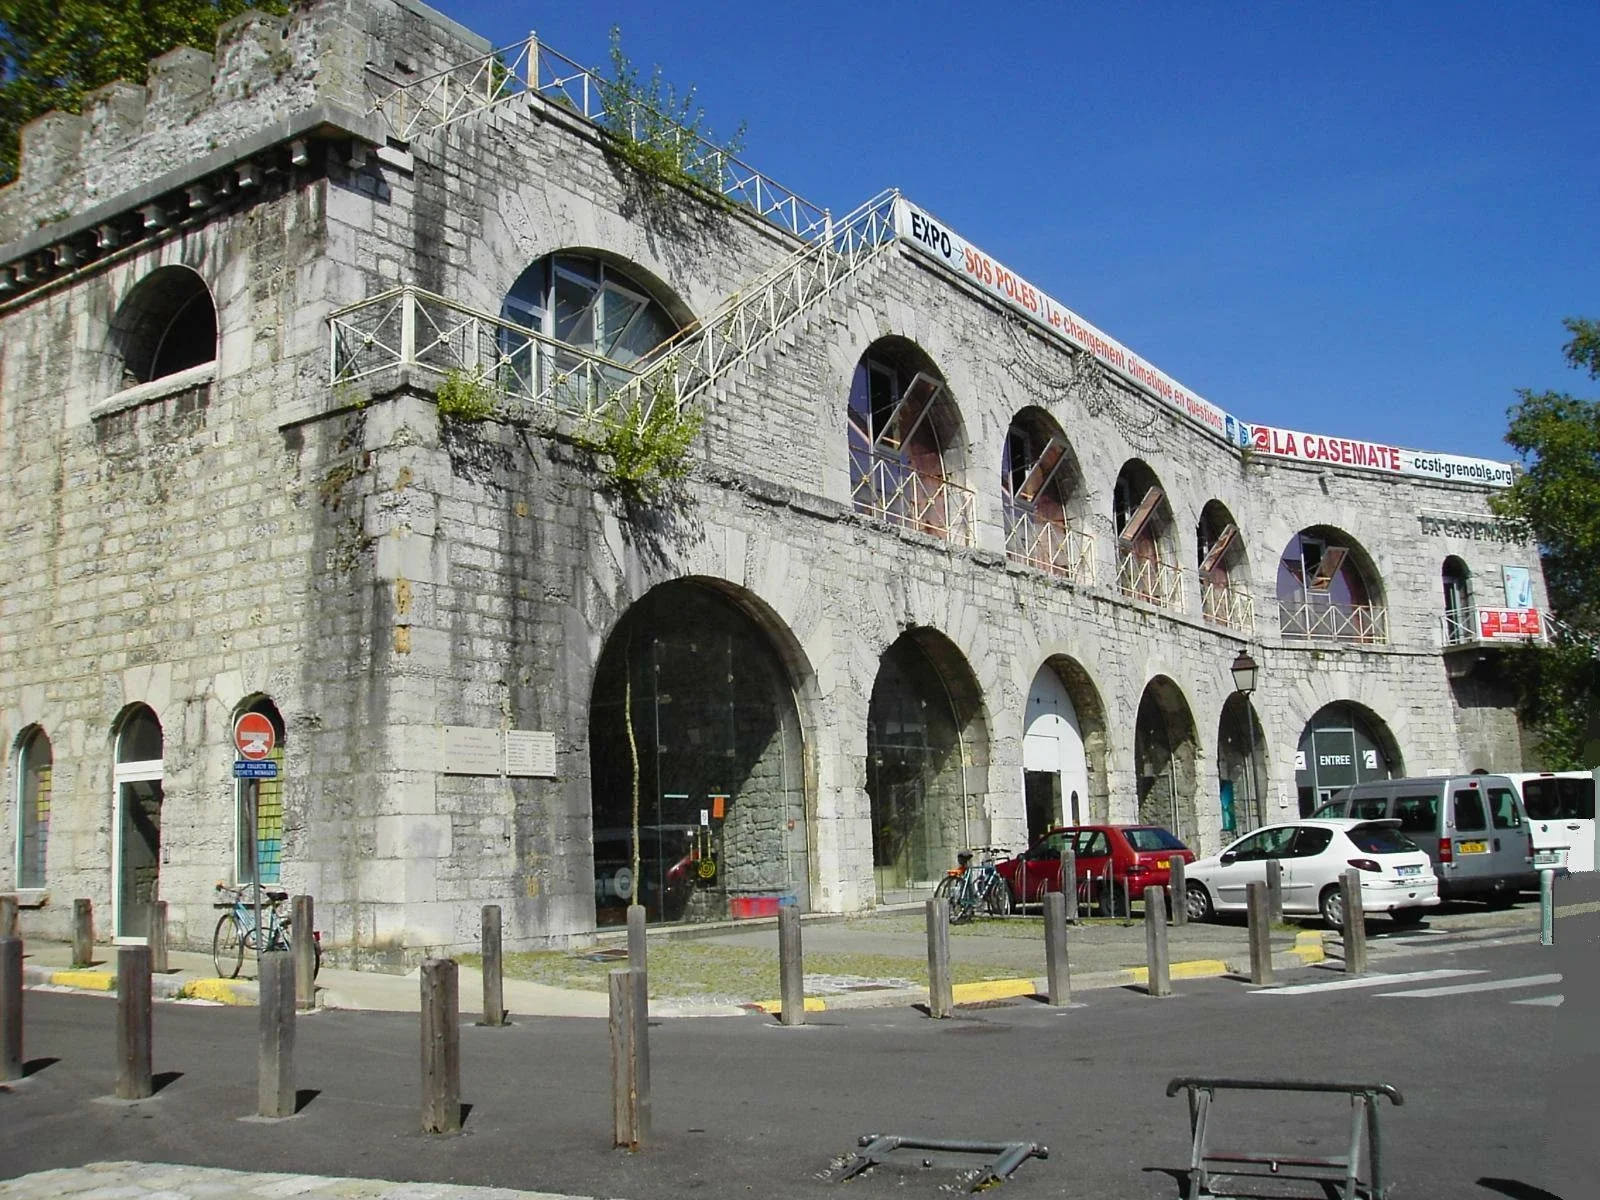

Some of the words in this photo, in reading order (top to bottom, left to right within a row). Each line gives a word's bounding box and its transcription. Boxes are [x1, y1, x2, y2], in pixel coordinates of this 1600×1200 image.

[911, 211, 952, 259] EXPO
[964, 247, 992, 285] SOS
[1045, 299, 1061, 328] Le
[1063, 314, 1125, 370] changement
[1128, 356, 1172, 400] climatique
[1174, 389, 1185, 408] en
[1186, 396, 1223, 431] questions
[1273, 430, 1298, 457] LA
[1303, 435, 1401, 470] CASEMATE
[1414, 457, 1512, 485] ccsti-grenoble.org
[1420, 518, 1440, 537] LA
[1319, 754, 1351, 766] ENTREE
